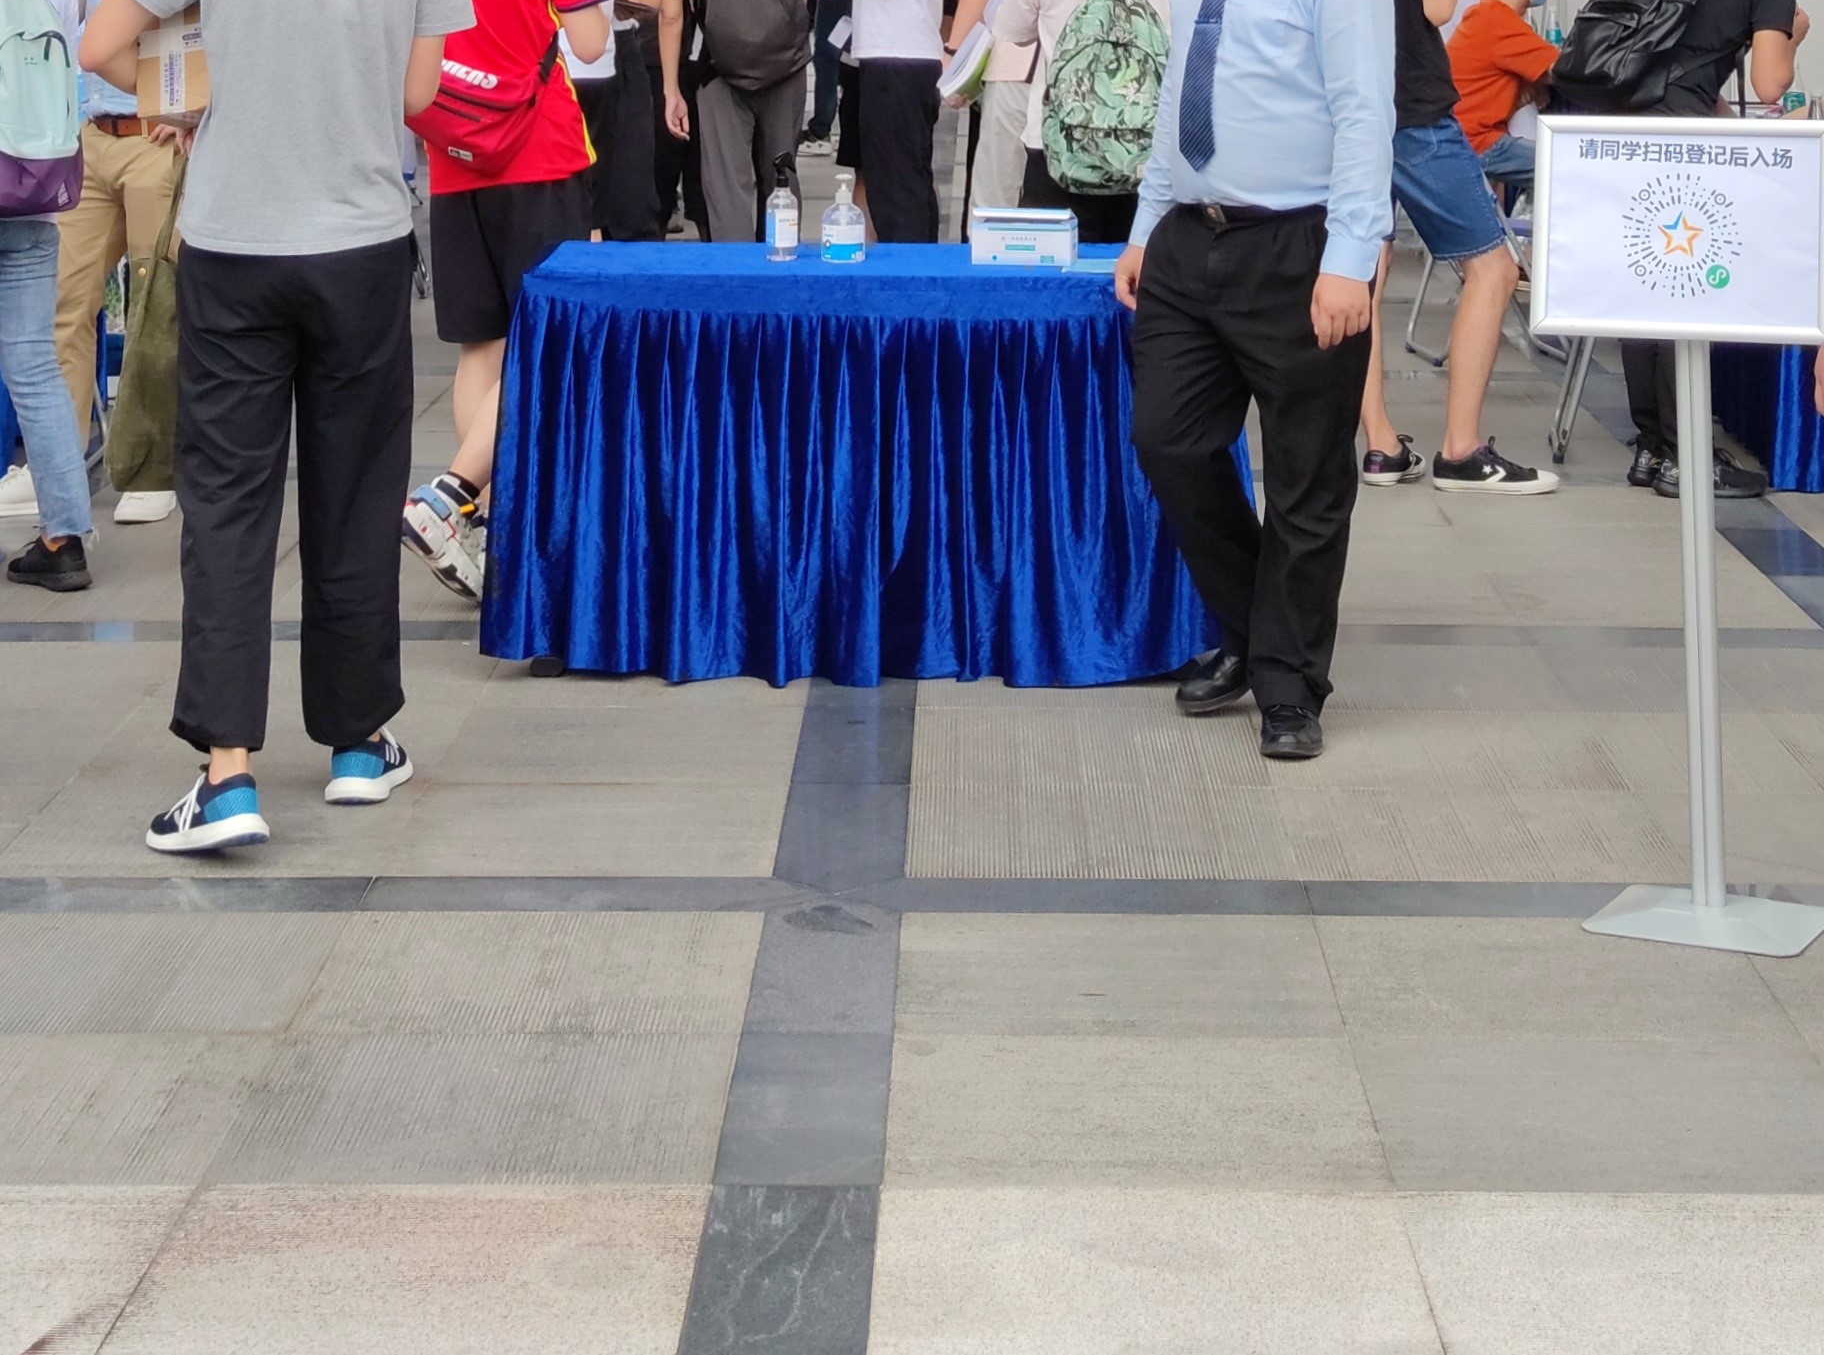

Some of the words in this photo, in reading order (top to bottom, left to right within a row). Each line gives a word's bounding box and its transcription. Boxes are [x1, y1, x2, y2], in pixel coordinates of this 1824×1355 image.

[1578, 138, 1794, 169] 请同学扫码登记后入场
